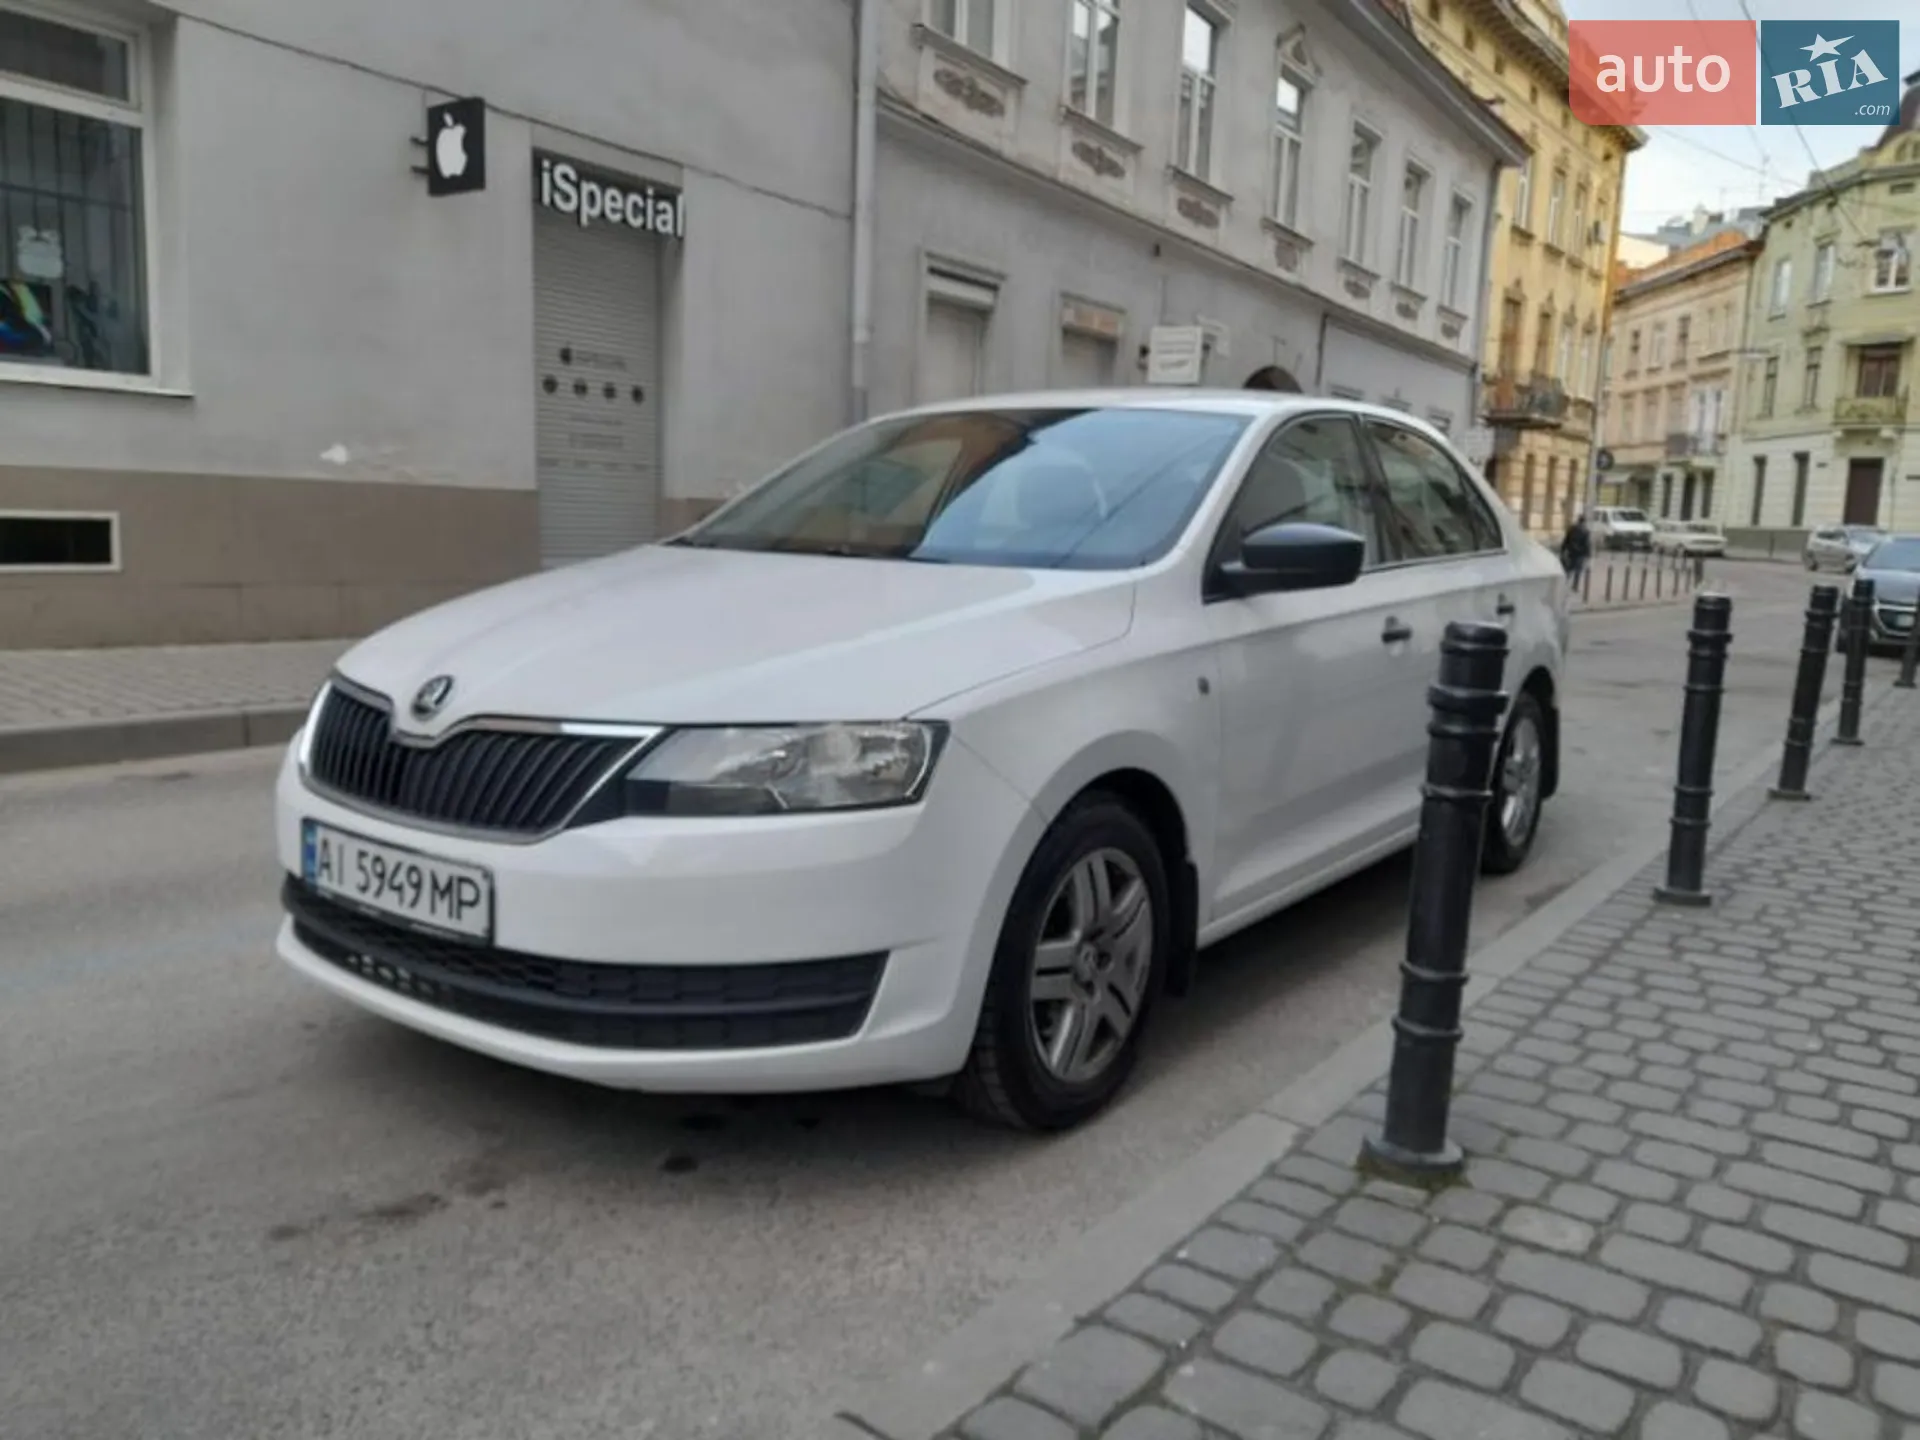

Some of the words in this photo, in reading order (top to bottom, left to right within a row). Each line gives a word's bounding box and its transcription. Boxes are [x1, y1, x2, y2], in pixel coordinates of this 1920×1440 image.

[541, 159, 684, 237] iSpecial
[318, 838, 345, 886] AI
[356, 849, 423, 909] 5949
[430, 870, 481, 921] MP
